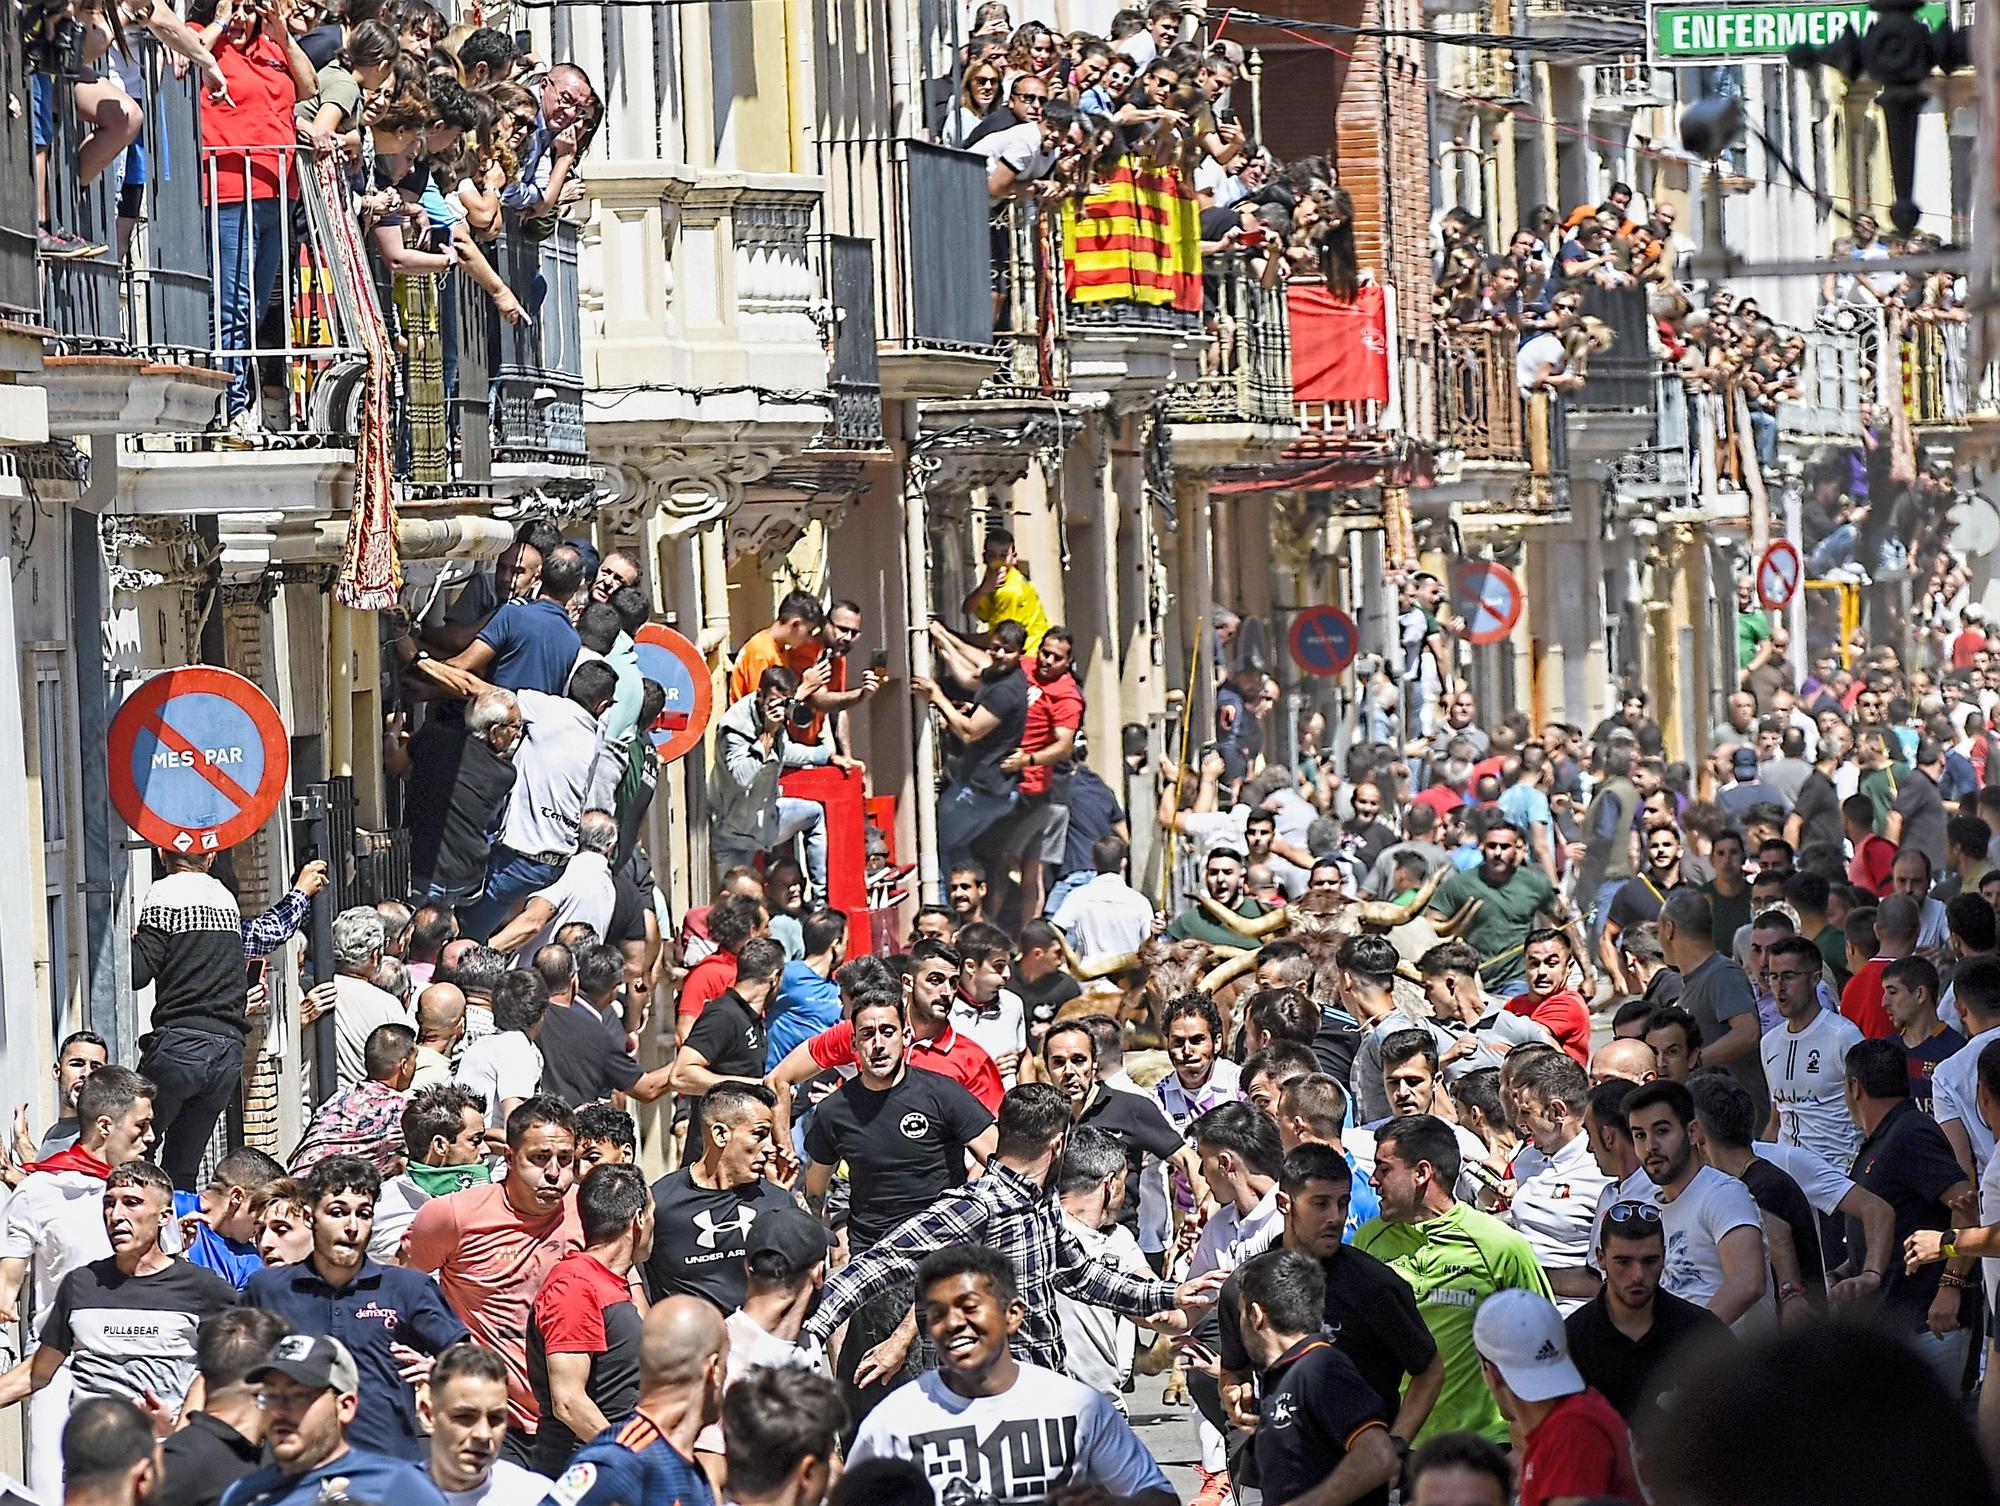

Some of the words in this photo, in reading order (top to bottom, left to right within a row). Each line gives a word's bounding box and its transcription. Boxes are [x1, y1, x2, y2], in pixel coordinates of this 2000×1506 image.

[151, 750, 195, 769] MES
[205, 747, 243, 765] PAR
[685, 1252, 725, 1264] UNDER
[103, 1325, 159, 1335] PULL&BEAR
